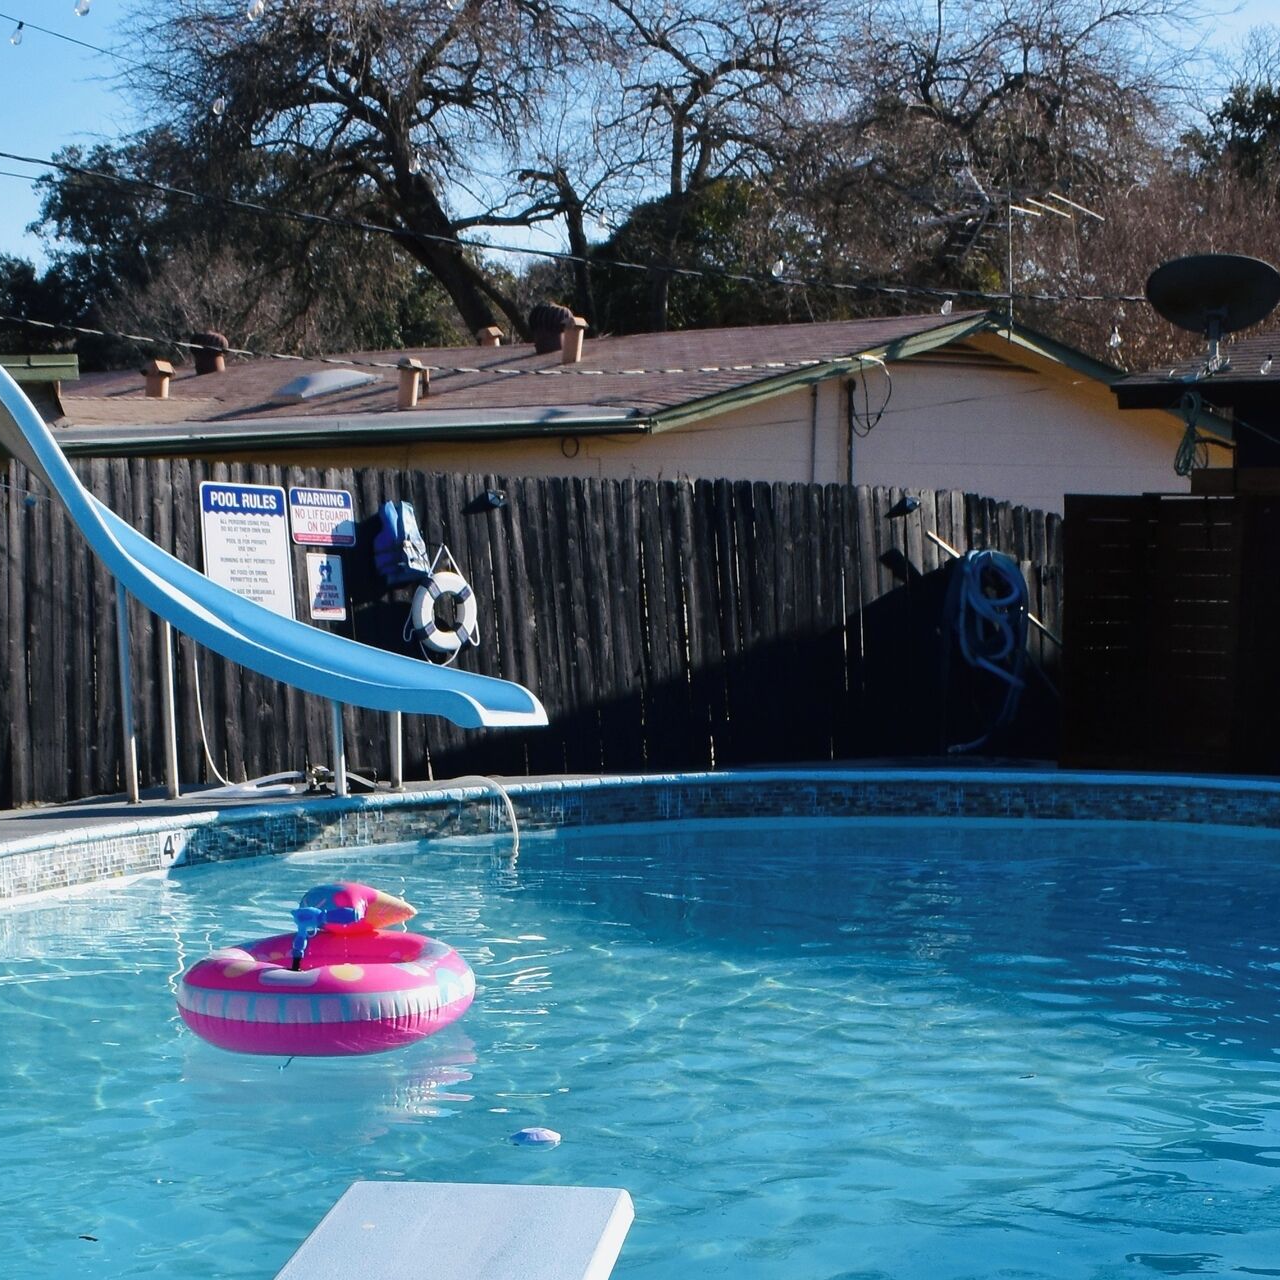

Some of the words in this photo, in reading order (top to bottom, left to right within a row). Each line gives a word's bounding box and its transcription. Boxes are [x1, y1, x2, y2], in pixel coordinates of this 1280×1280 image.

[210, 491, 240, 507] POOL
[242, 493, 277, 509] RULES
[297, 491, 344, 507] WARNING
[295, 508, 305, 519] NO
[307, 510, 349, 521] LIFEGUARD
[307, 521, 318, 532] ON
[164, 835, 175, 859] 4
